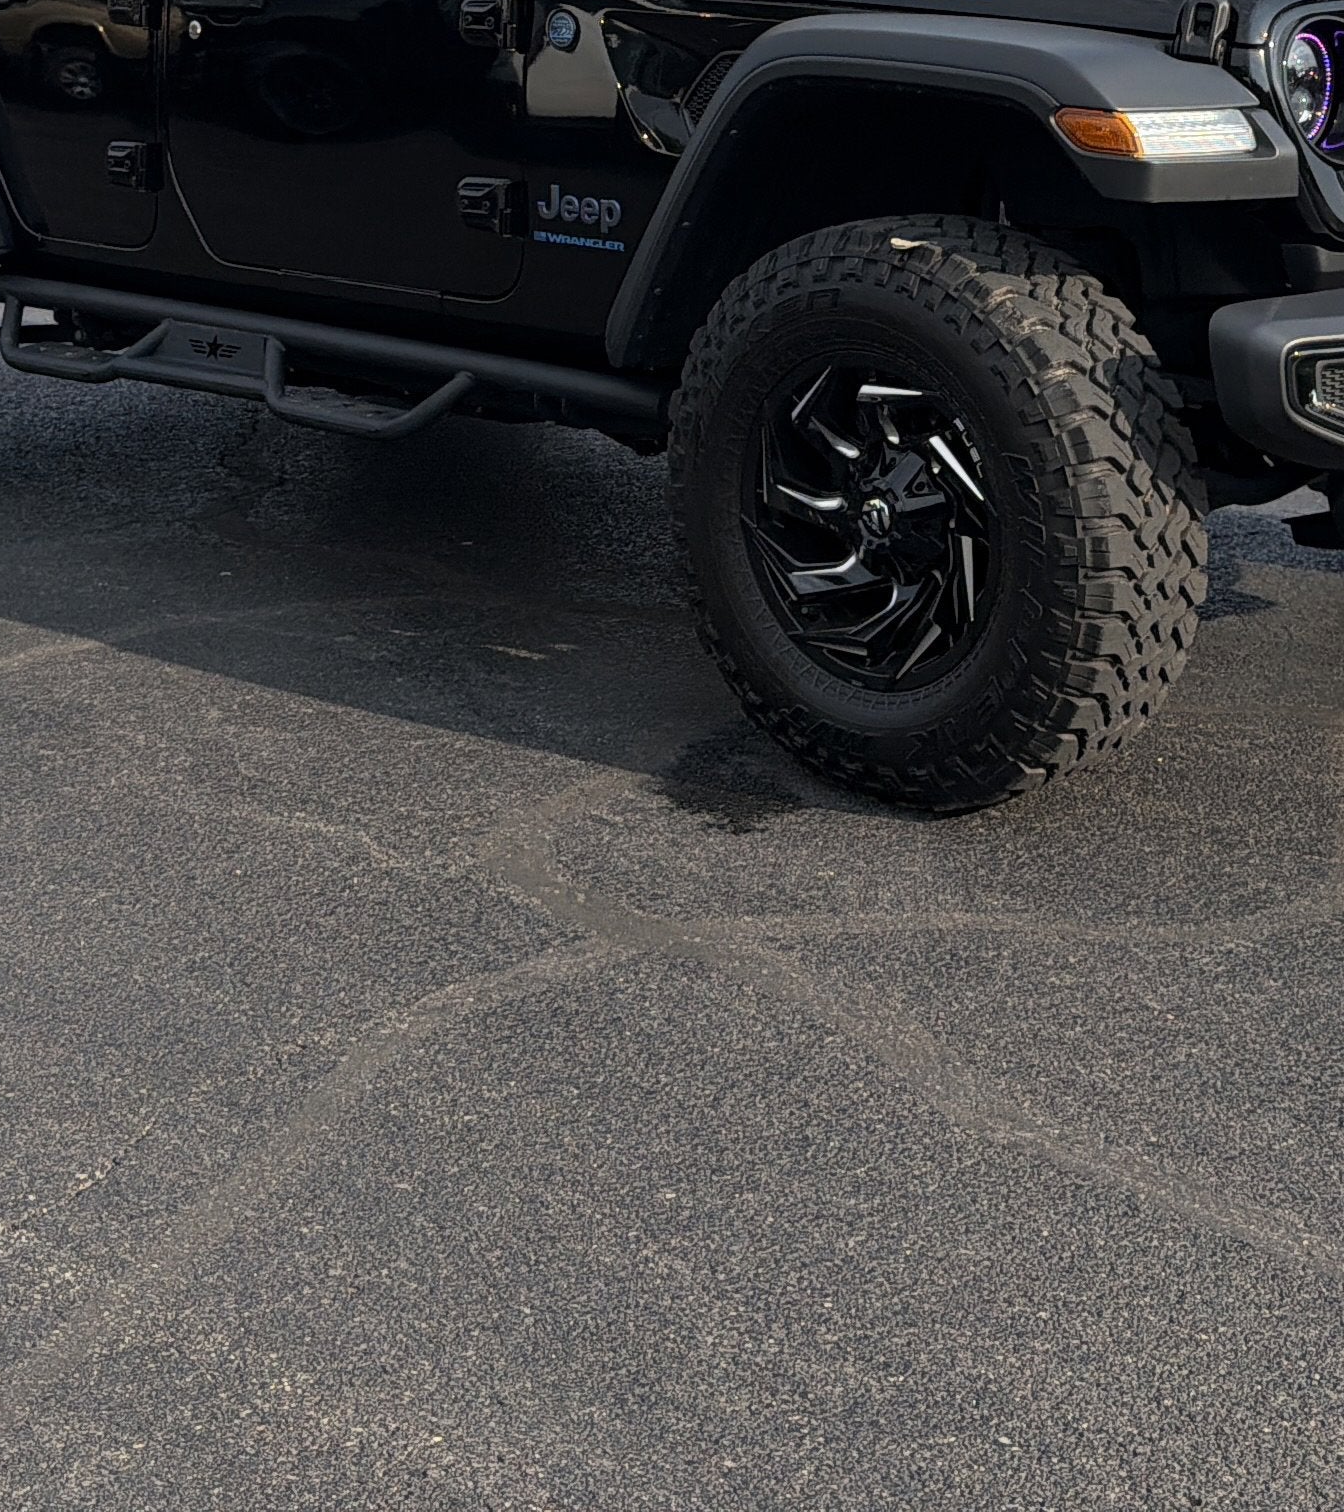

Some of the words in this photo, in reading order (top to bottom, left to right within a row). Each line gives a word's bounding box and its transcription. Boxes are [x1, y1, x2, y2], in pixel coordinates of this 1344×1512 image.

[536, 183, 622, 235] Jeep
[546, 231, 625, 253] WRANGLER
[952, 417, 984, 479] FUEL
